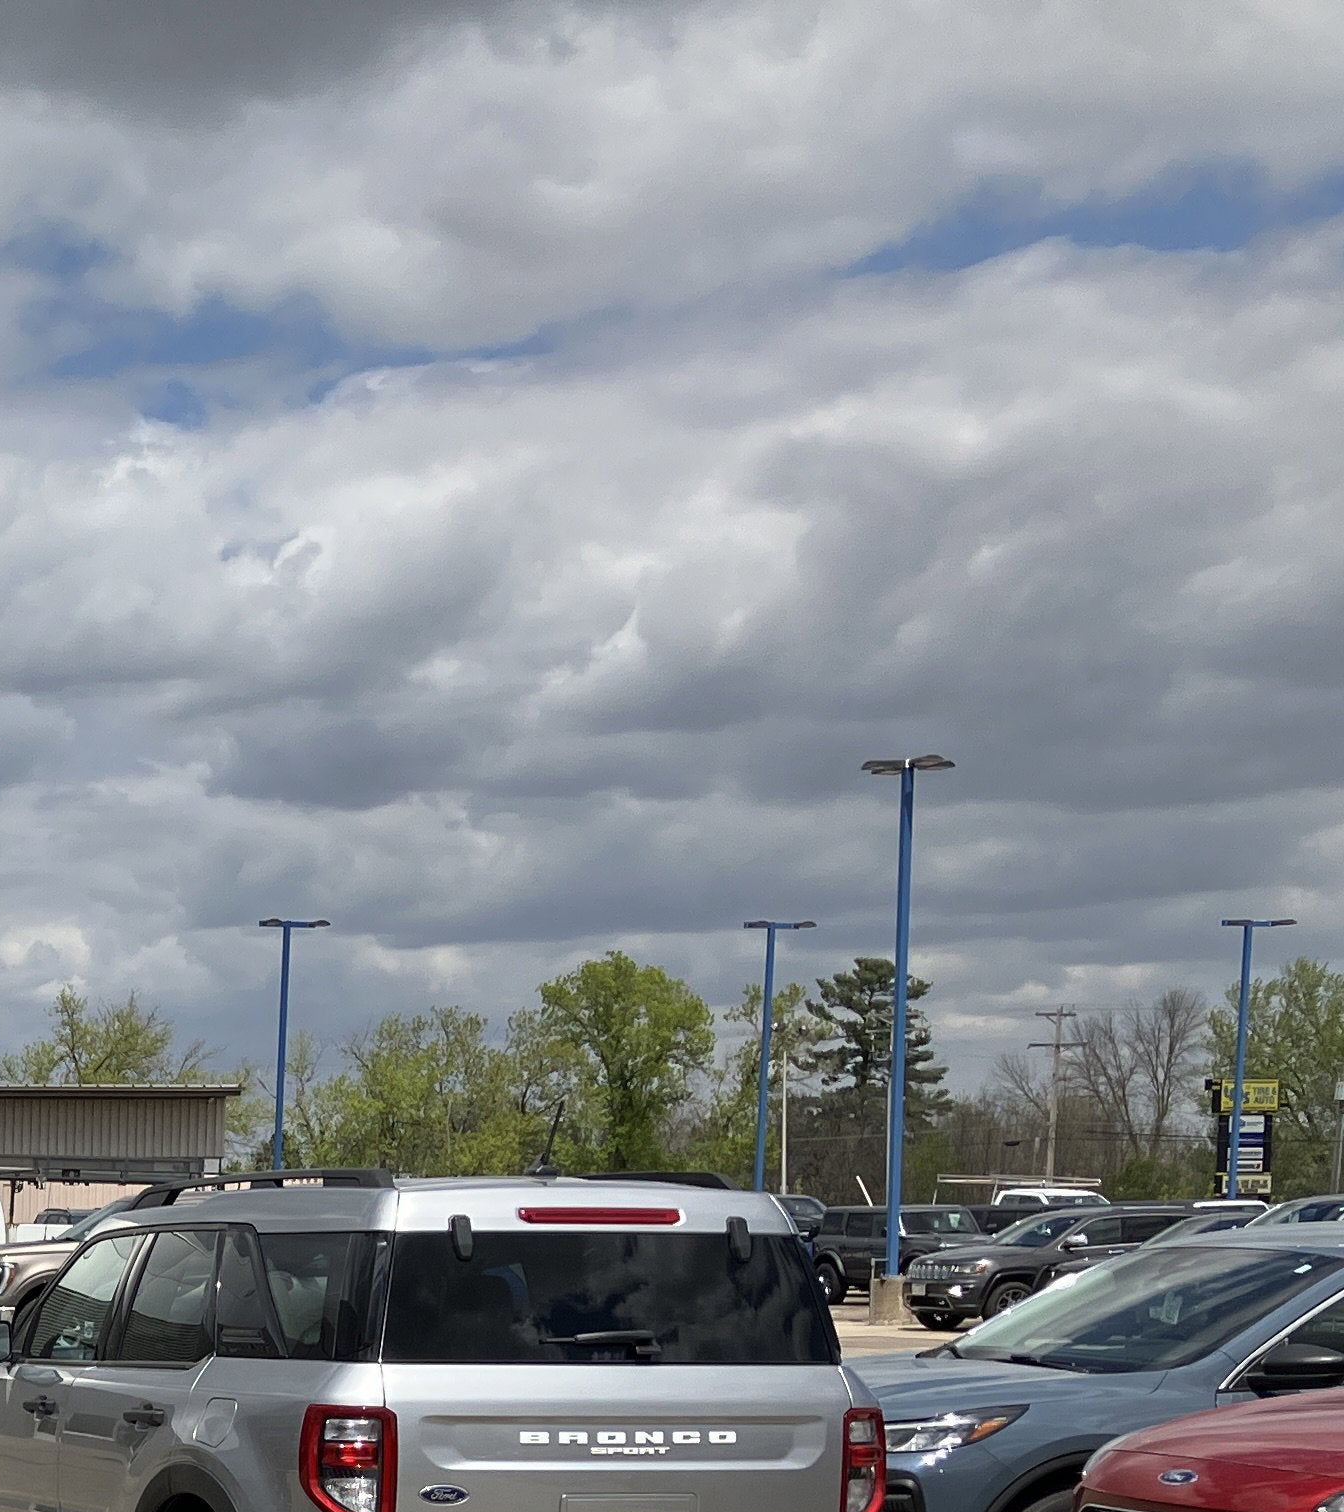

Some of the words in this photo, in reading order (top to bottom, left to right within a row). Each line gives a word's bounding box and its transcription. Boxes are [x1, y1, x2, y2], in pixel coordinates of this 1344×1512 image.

[519, 1431, 737, 1445] BRONCO
[590, 1446, 670, 1455] SPORT
[431, 1488, 458, 1500] Ford
